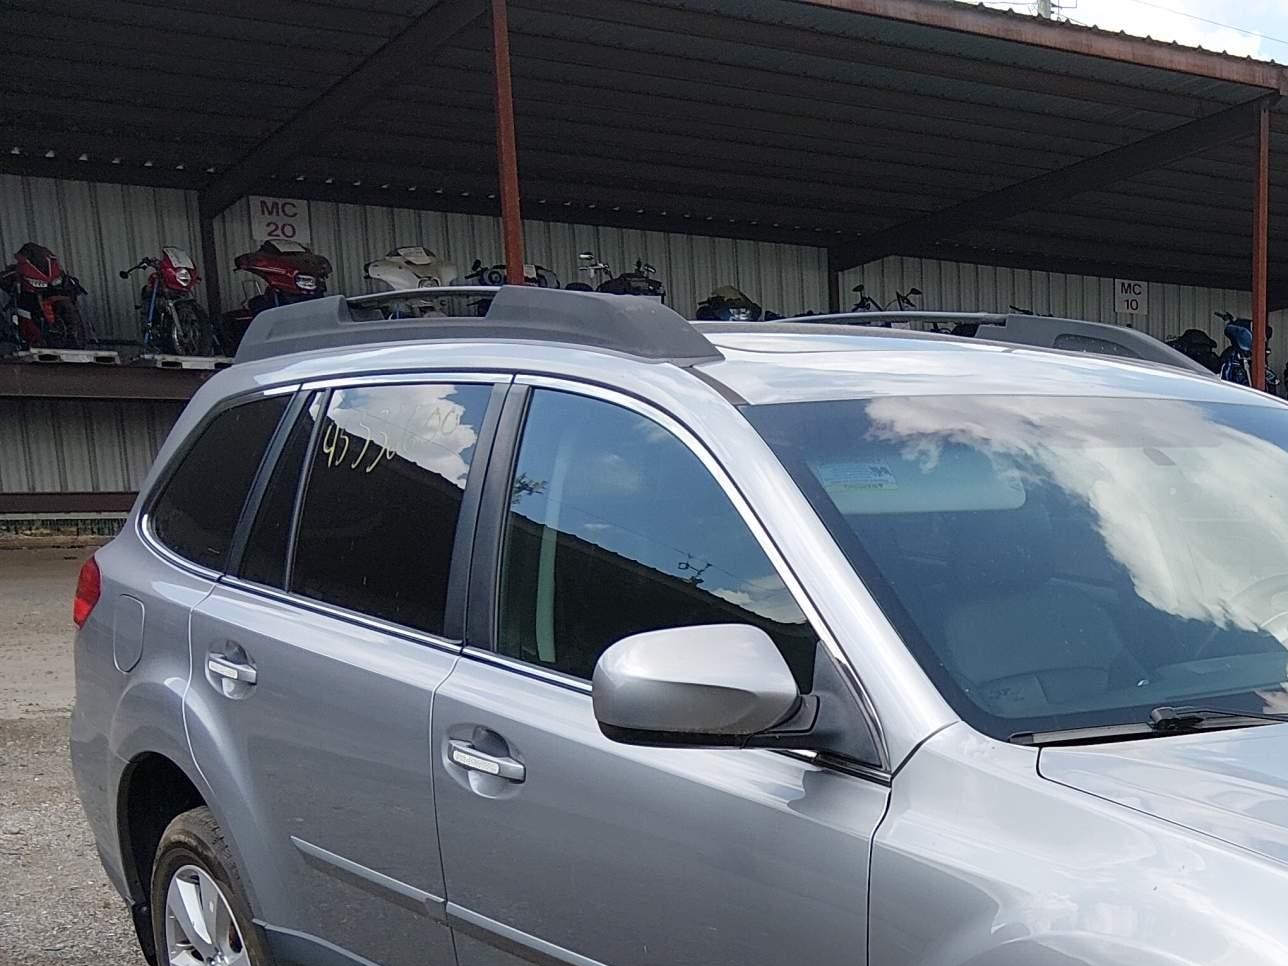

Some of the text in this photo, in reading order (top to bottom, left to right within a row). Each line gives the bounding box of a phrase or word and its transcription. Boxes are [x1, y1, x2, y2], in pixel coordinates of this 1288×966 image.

[260, 200, 298, 218] MC
[266, 221, 296, 238] 20
[1121, 281, 1142, 295] MC
[1124, 299, 1138, 311] 10
